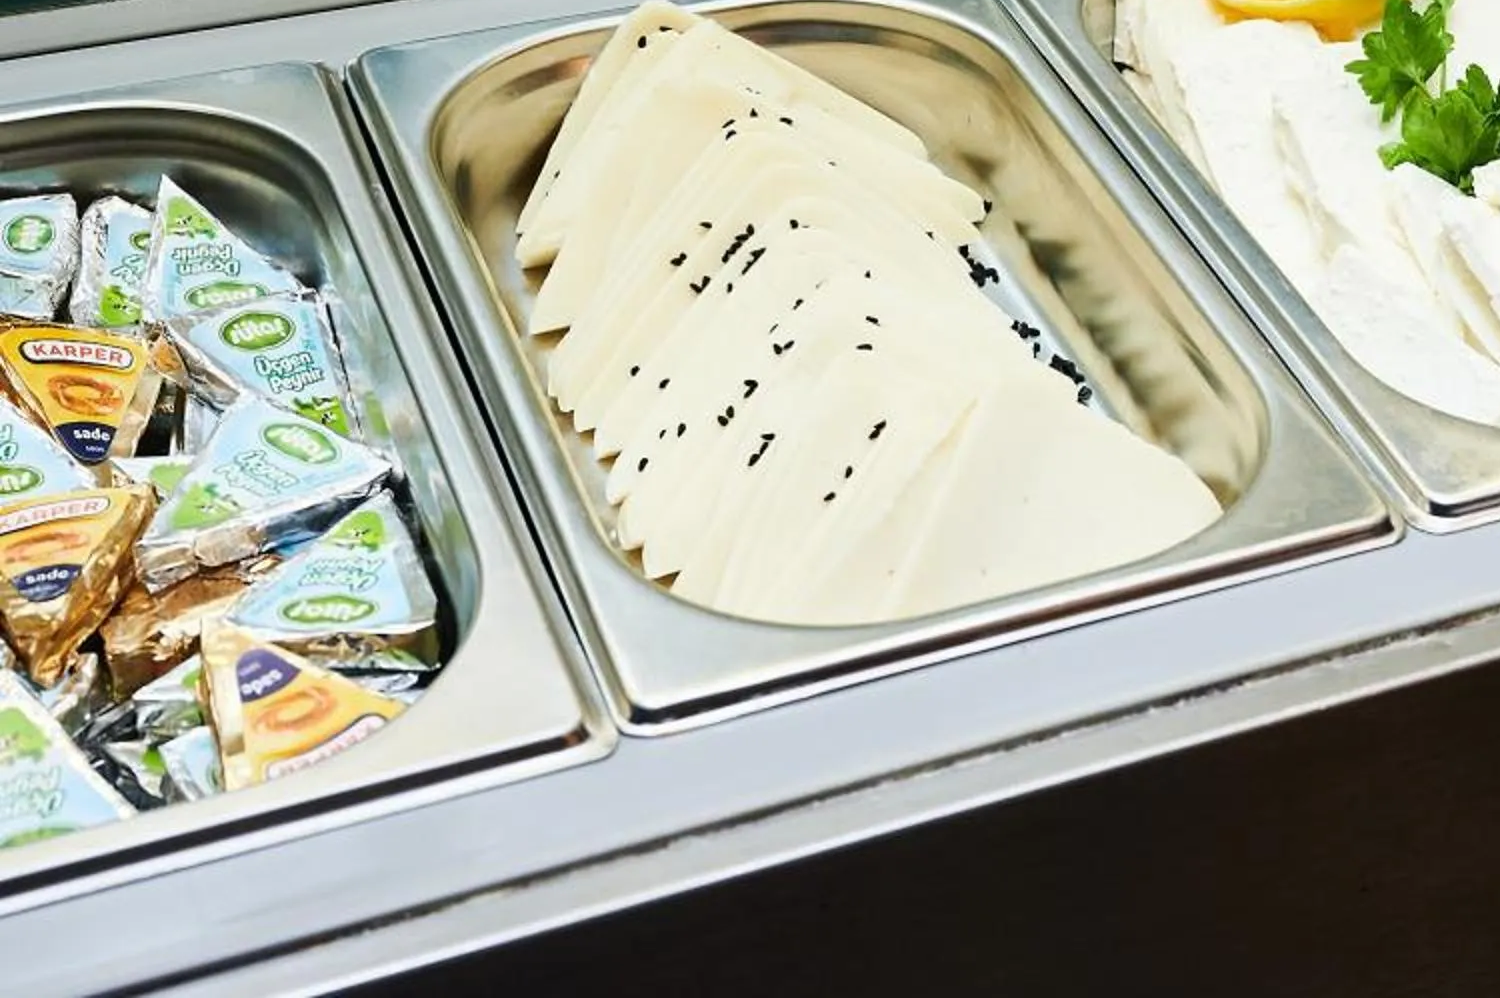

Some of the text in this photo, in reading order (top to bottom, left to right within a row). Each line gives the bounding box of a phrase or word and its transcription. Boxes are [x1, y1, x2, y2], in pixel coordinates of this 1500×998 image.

[32, 343, 124, 365] KARPER
[269, 368, 325, 393] Peynir
[73, 427, 111, 441] sade
[25, 568, 70, 584] sade
